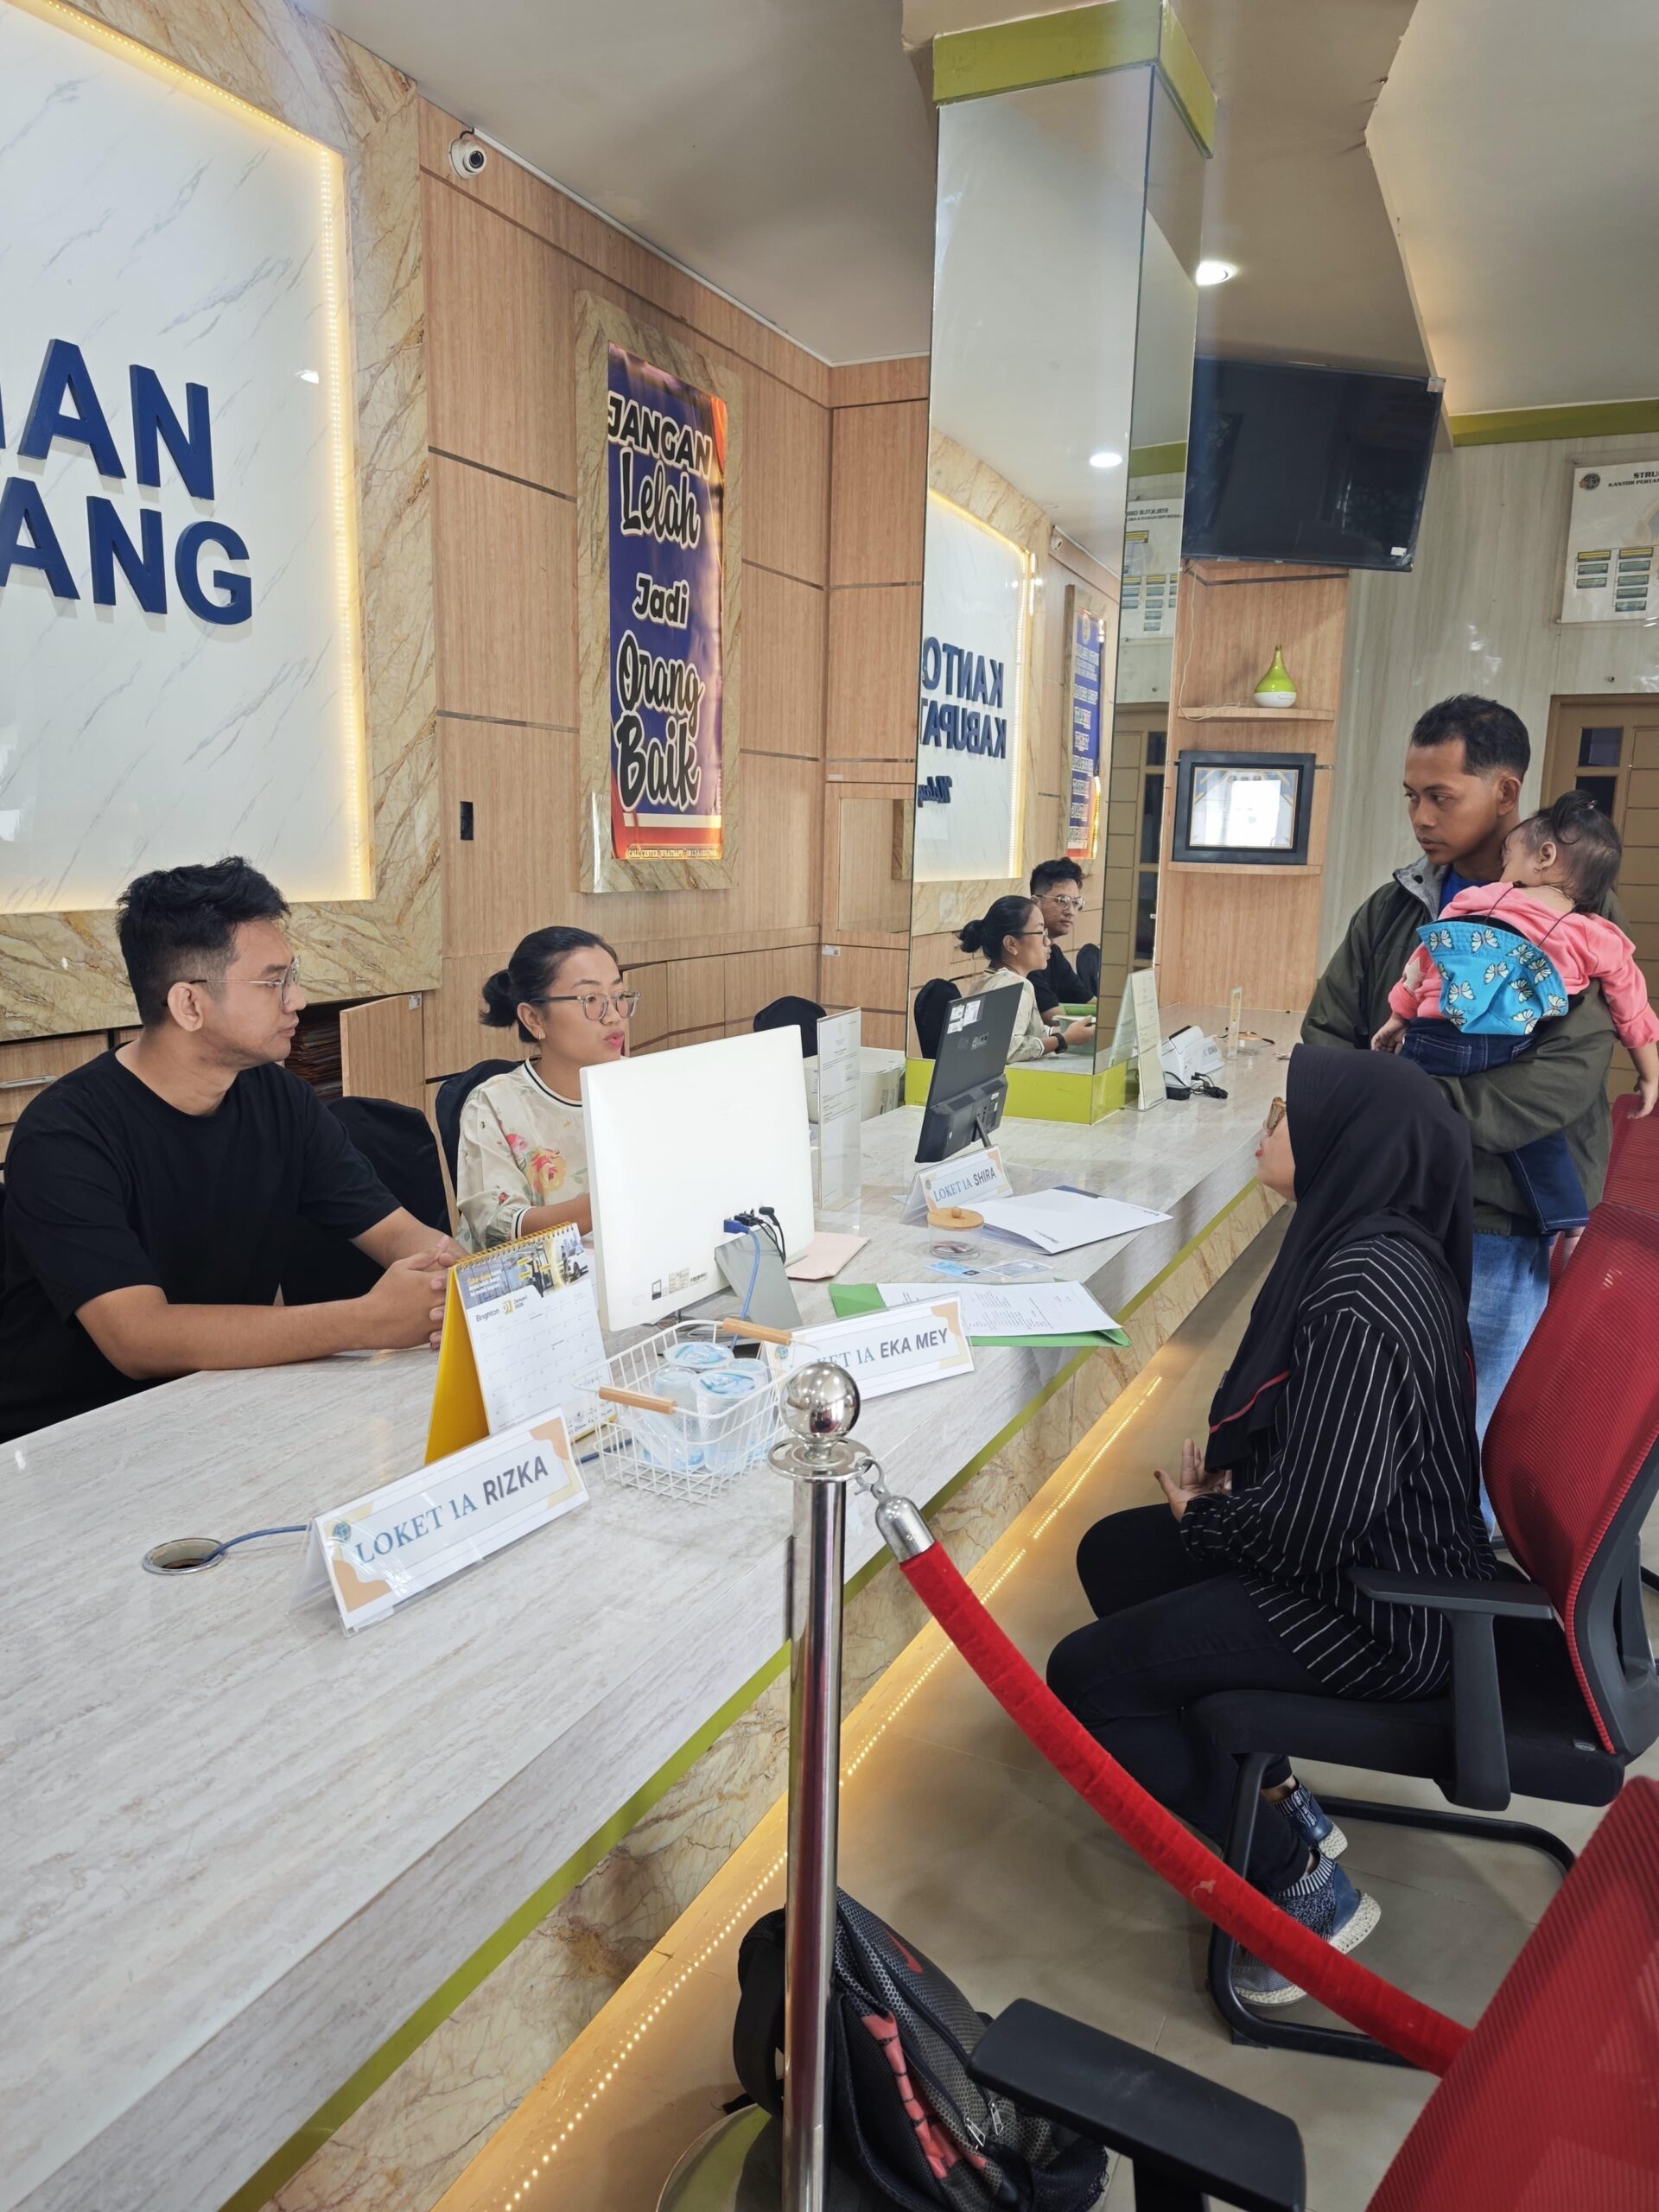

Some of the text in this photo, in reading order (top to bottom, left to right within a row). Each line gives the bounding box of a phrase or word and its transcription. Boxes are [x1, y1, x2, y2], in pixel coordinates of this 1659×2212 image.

[0, 338, 214, 501] AN
[608, 391, 713, 480] JANGAN
[620, 447, 701, 549] Lelah
[0, 476, 252, 626] ANG
[632, 573, 689, 628] Jadi
[617, 630, 705, 741] Orang
[614, 710, 702, 812] Baik
[933, 1181, 961, 1202] LOKET
[973, 1166, 997, 1186] SHIRA
[475, 1308, 500, 1321] Brighton
[880, 1337, 912, 1358] EKA
[916, 1327, 948, 1350] MEY
[355, 1505, 443, 1563] LOKET
[482, 1455, 549, 1505] RIZKA
